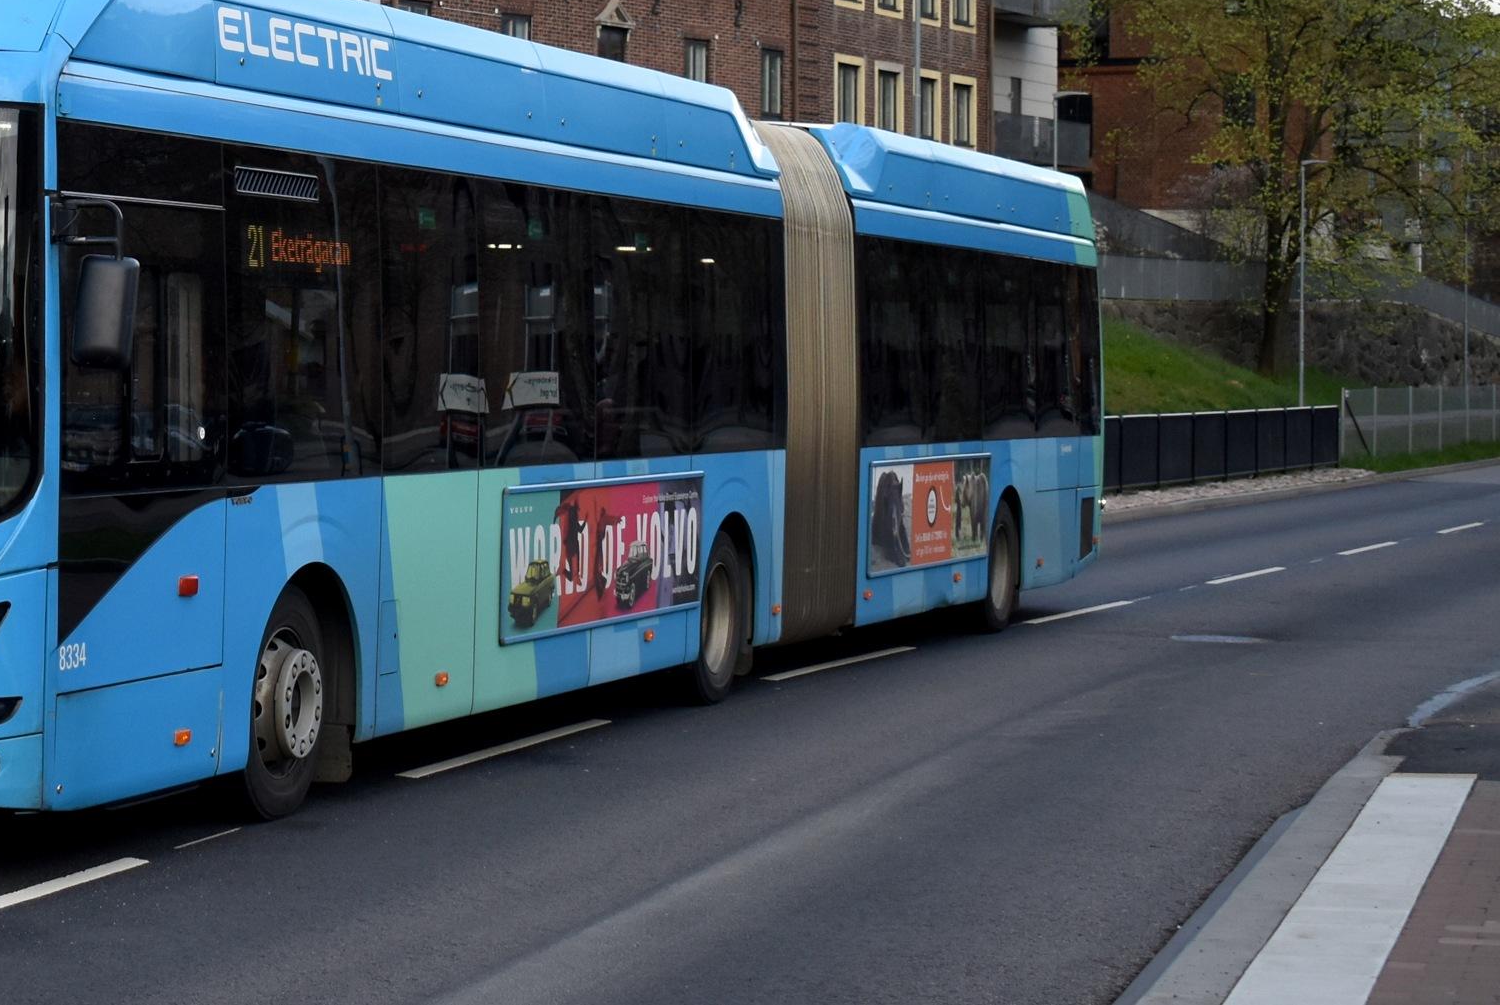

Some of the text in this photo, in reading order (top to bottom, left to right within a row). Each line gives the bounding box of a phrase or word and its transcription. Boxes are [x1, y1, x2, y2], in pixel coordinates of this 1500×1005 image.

[218, 6, 393, 81] ELECTRIC
[248, 224, 350, 273] 21 Eketrägatan
[510, 506, 533, 515] VOLVO
[602, 515, 626, 594] OF
[59, 642, 87, 671] 8334
